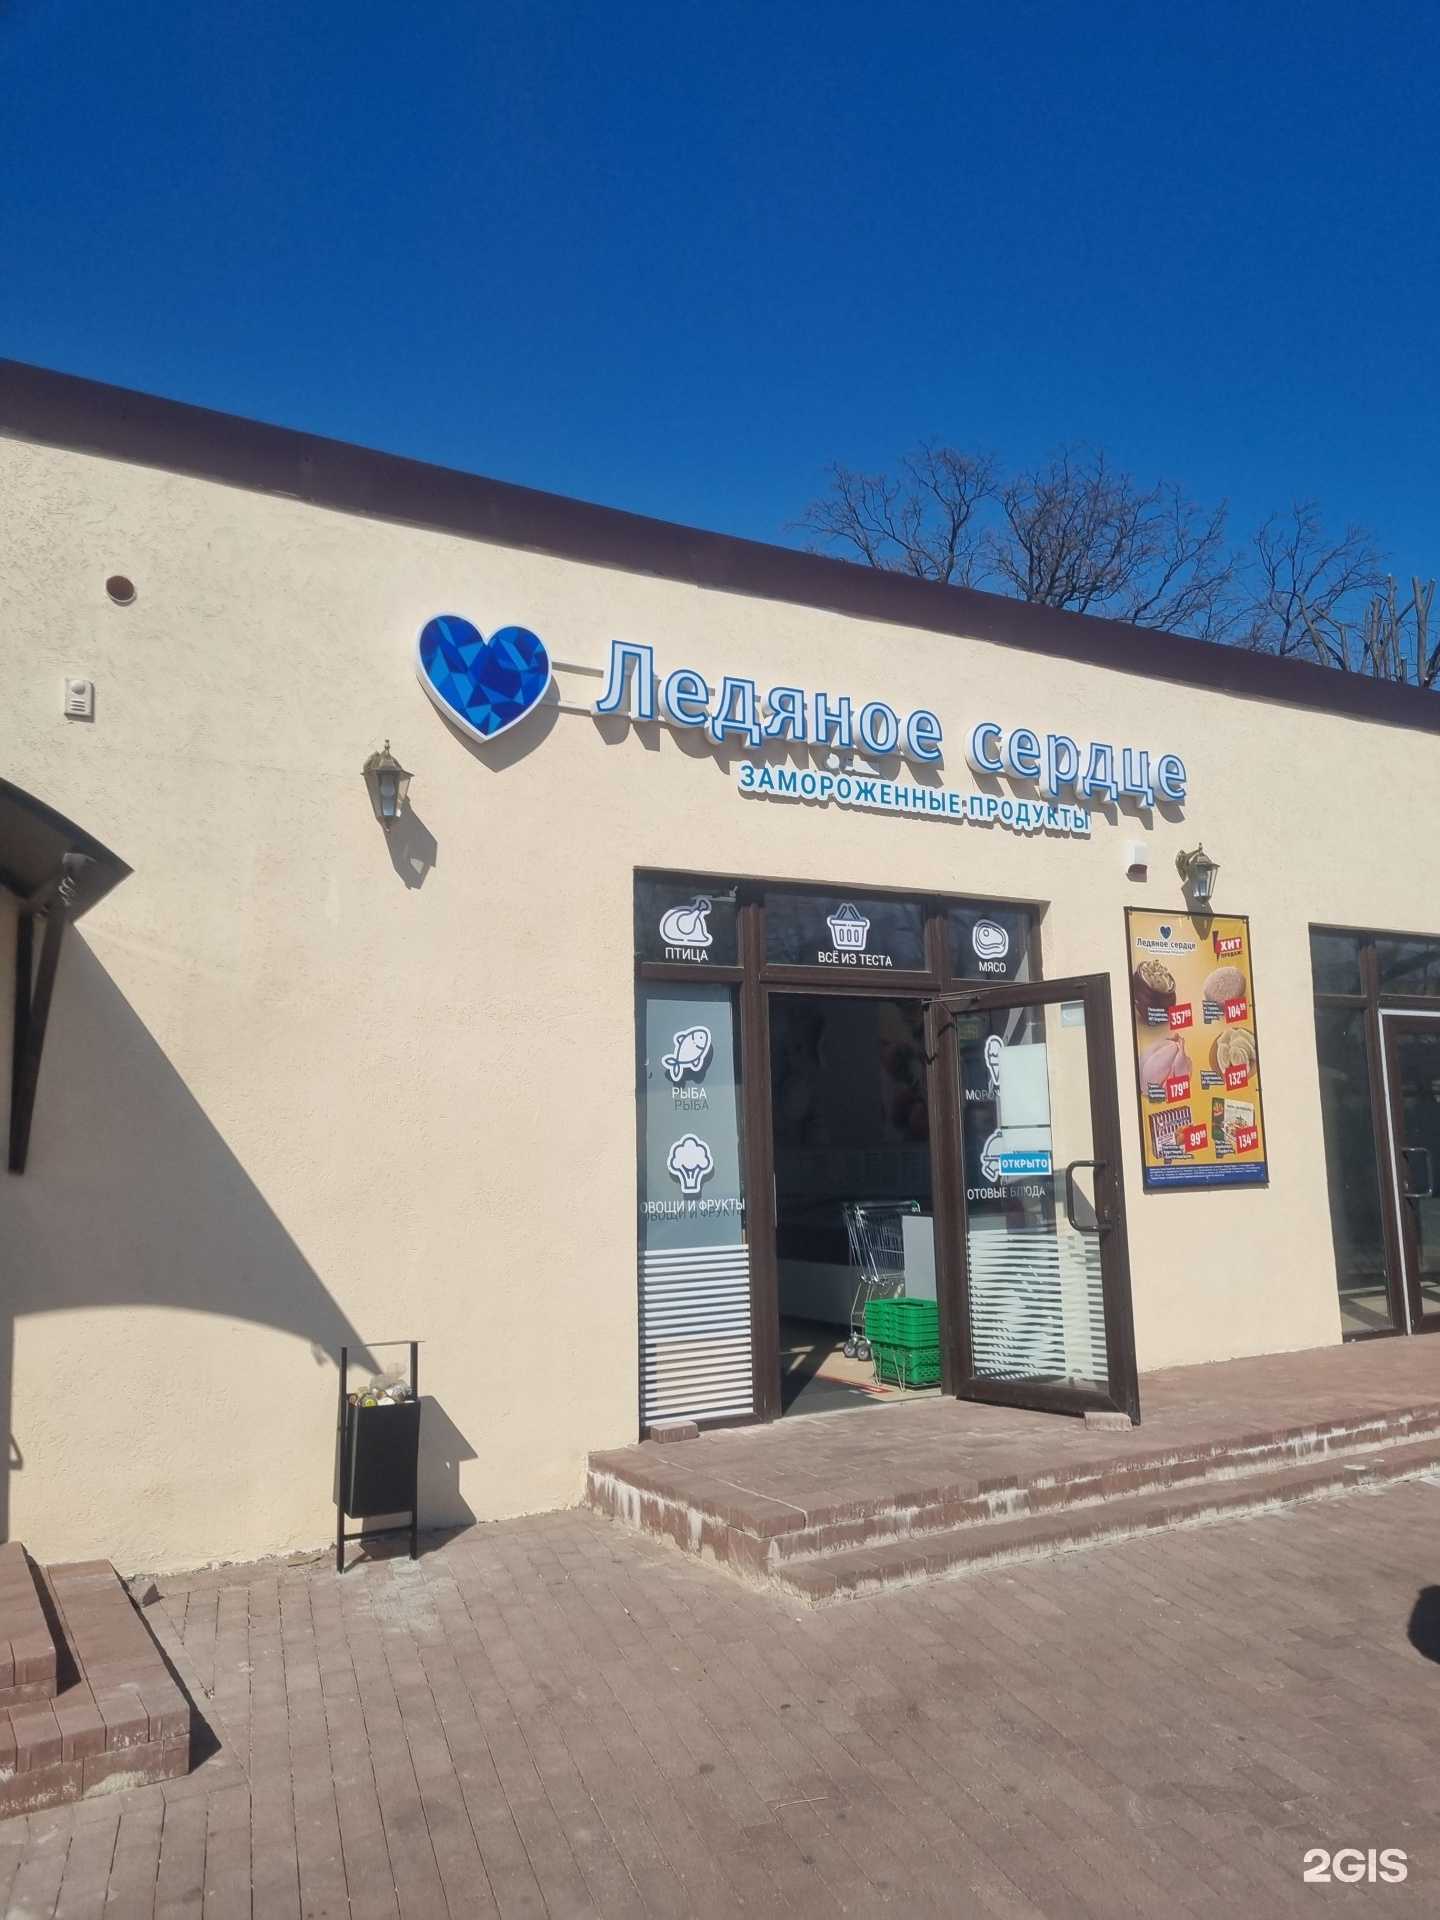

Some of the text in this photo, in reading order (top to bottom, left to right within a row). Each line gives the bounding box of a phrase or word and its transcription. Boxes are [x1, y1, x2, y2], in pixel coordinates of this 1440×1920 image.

[596, 639, 1187, 808] Ледяное сердце
[740, 765, 1090, 831] ЗАМОРОЖЕННЫЕ ПРОДУКТЫ
[1220, 938, 1241, 951] ХИТ
[665, 947, 709, 962] ПТИЦА
[818, 951, 893, 967] ВСЁ ИЗ ТЕСТА
[978, 961, 1007, 973] МЯСО
[672, 1087, 707, 1099] РЫБА
[1002, 1157, 1048, 1169] ОТКРЫТО
[967, 1187, 1008, 1200] ОТОВЫЕ
[640, 1197, 745, 1215] ОВОЩИ И ФРУКТЫ
